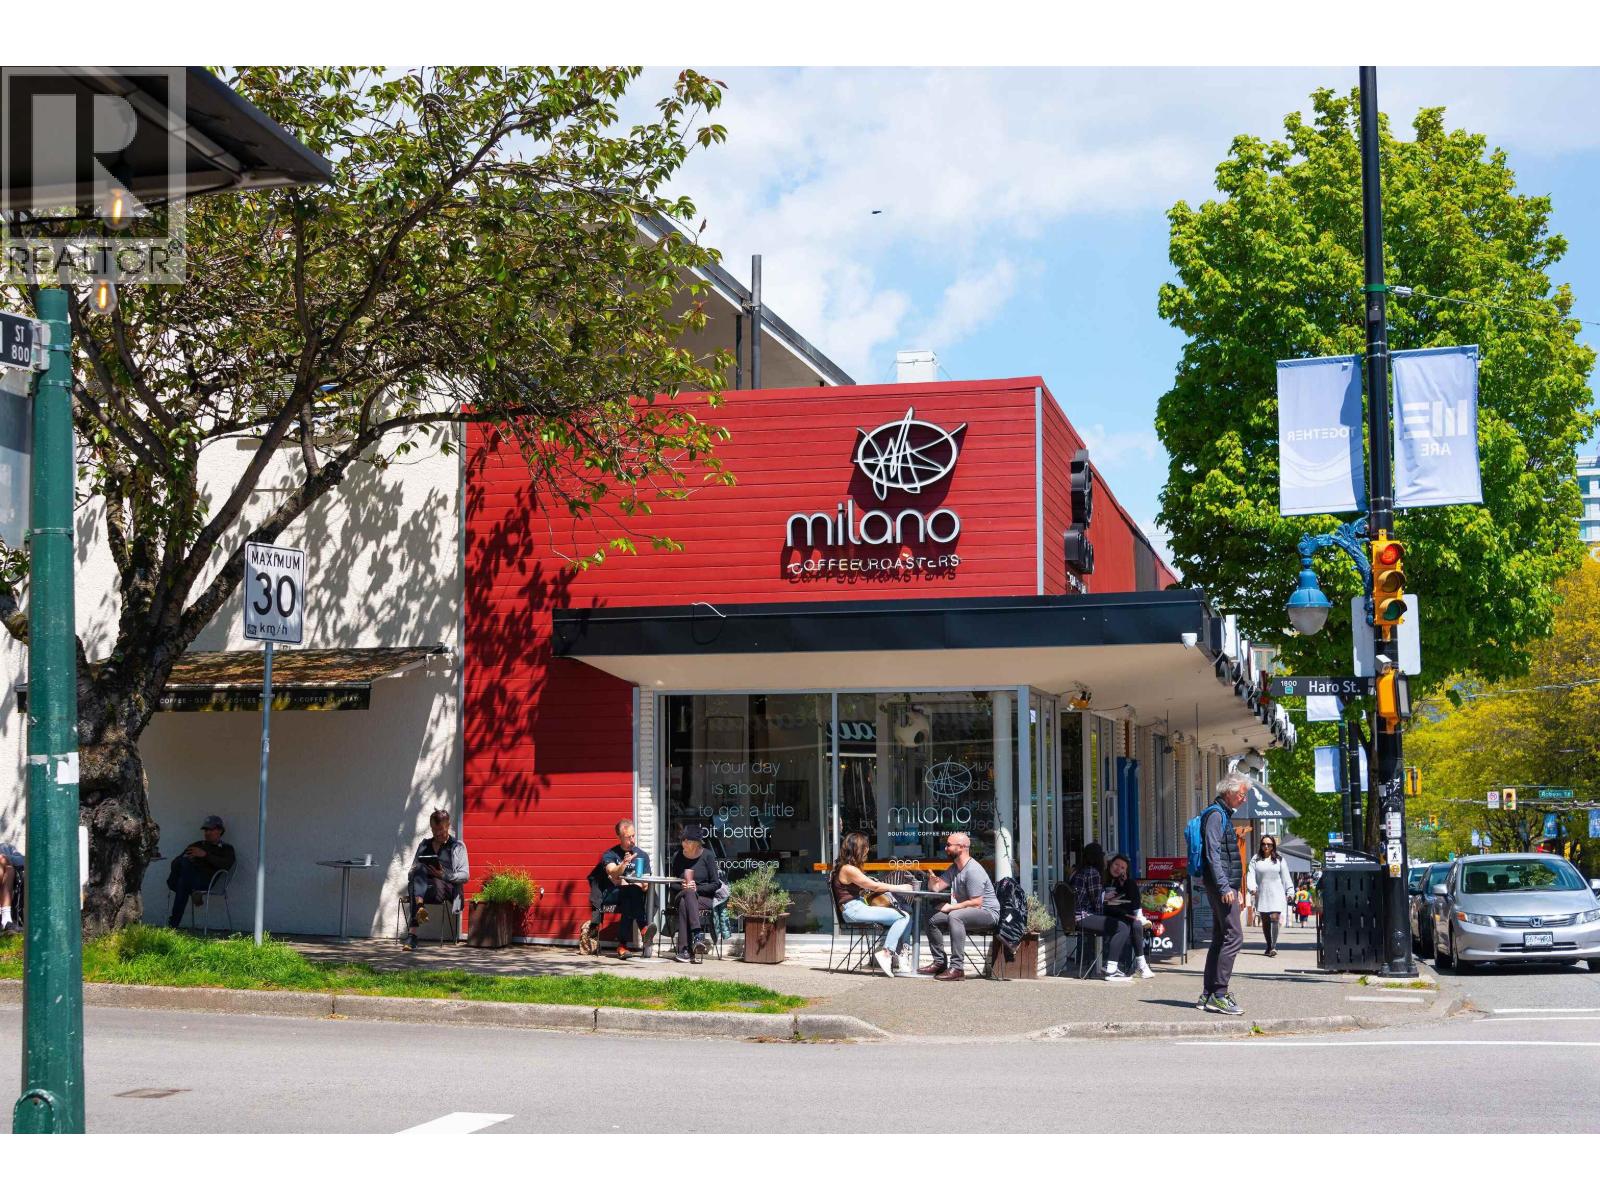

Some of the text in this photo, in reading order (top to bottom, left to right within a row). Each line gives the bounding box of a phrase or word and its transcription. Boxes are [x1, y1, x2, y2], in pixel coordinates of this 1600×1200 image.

[15, 324, 25, 343] ST
[11, 344, 30, 363] 800
[786, 498, 961, 547] milano
[251, 550, 300, 570] MAXIMUM
[788, 557, 860, 575] COFFEE
[253, 572, 296, 618] 30
[259, 622, 288, 637] km/h
[1308, 680, 1361, 693] Haro St.
[711, 759, 781, 777] Your day
[711, 780, 776, 795] is about
[698, 801, 796, 822] to get a little
[887, 800, 972, 824] milano
[723, 823, 773, 839] better.
[888, 858, 921, 870] open
